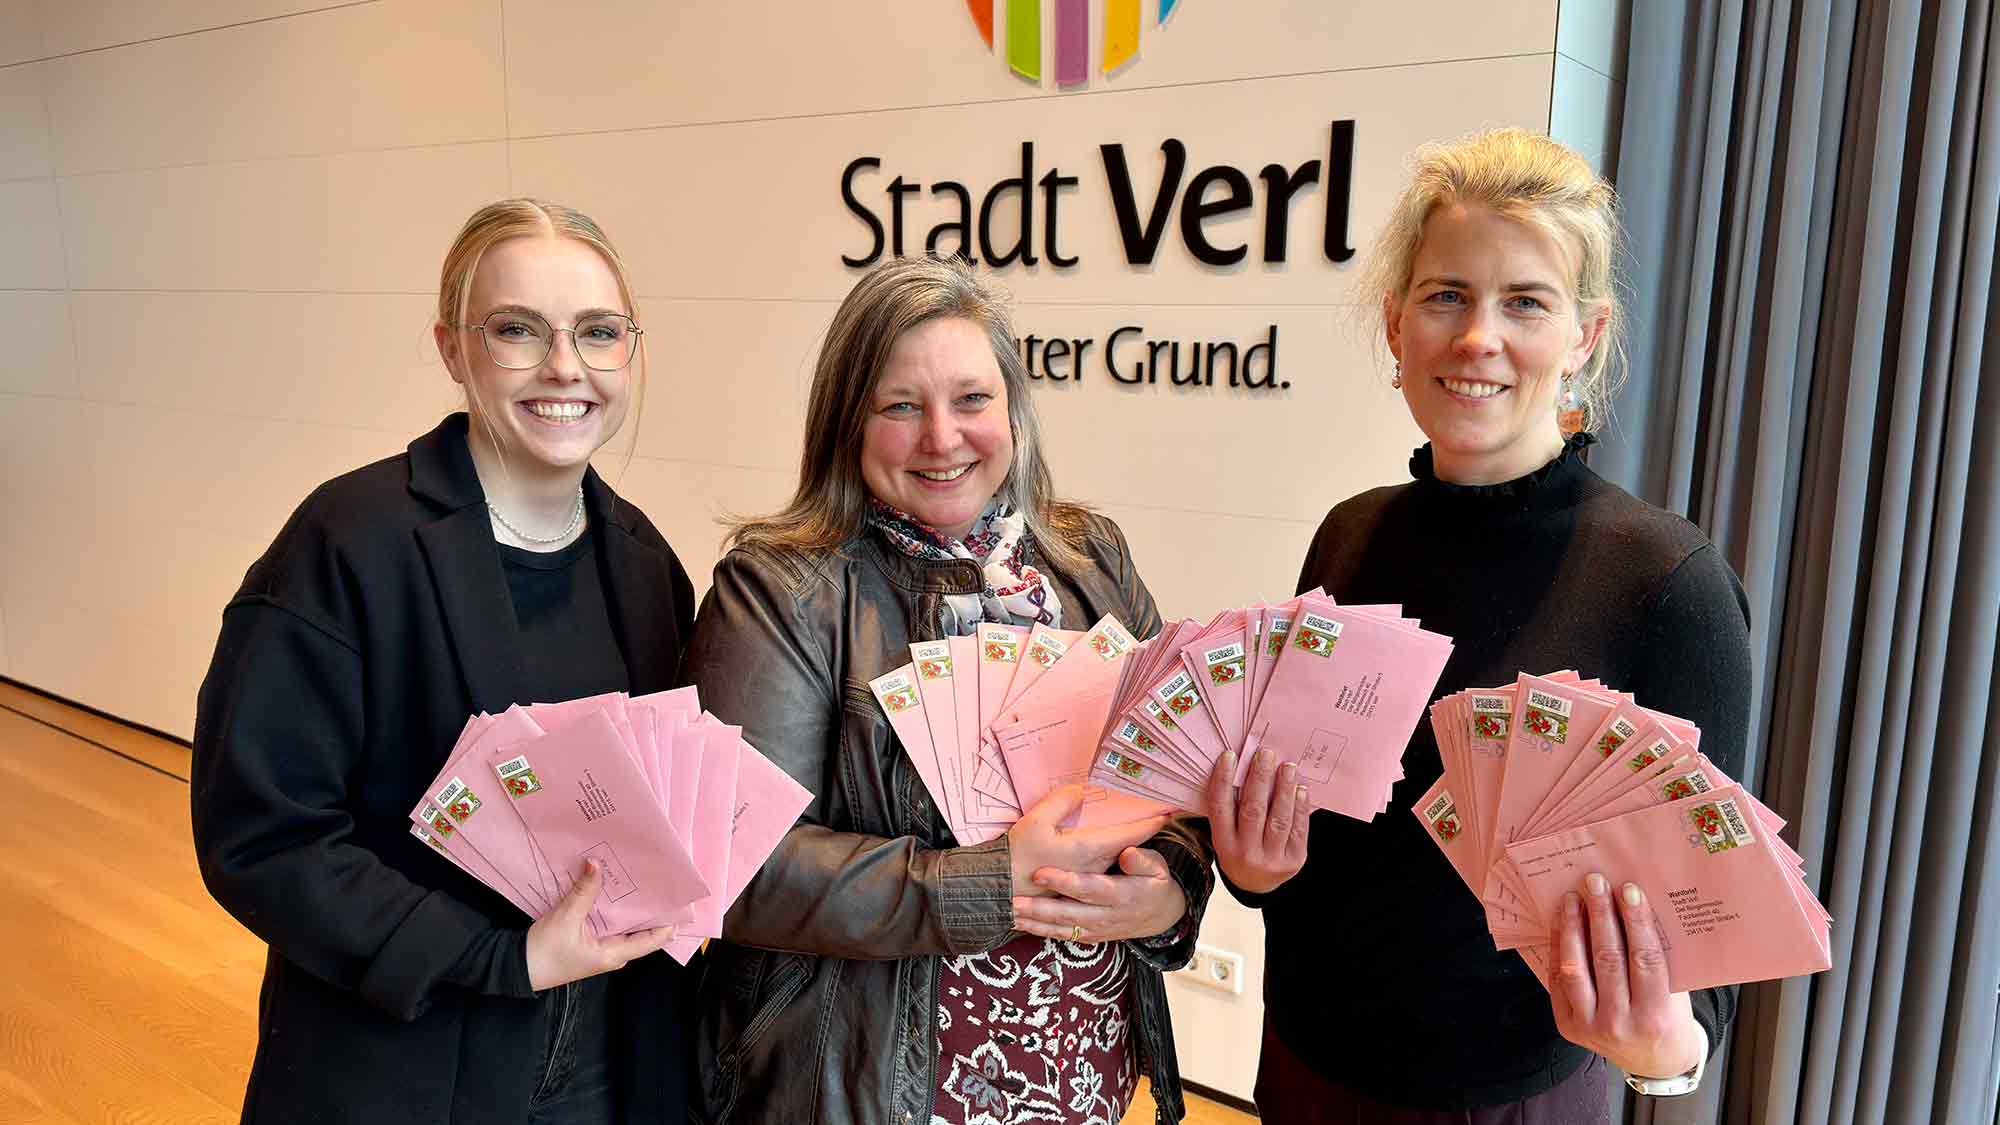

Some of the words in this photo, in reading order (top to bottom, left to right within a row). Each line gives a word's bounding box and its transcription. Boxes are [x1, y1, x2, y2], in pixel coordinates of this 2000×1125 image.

[841, 141, 1079, 267] Stadt
[1100, 119, 1356, 267] Verl
[1016, 333, 1094, 381] ter
[1105, 324, 1291, 389] Grund.
